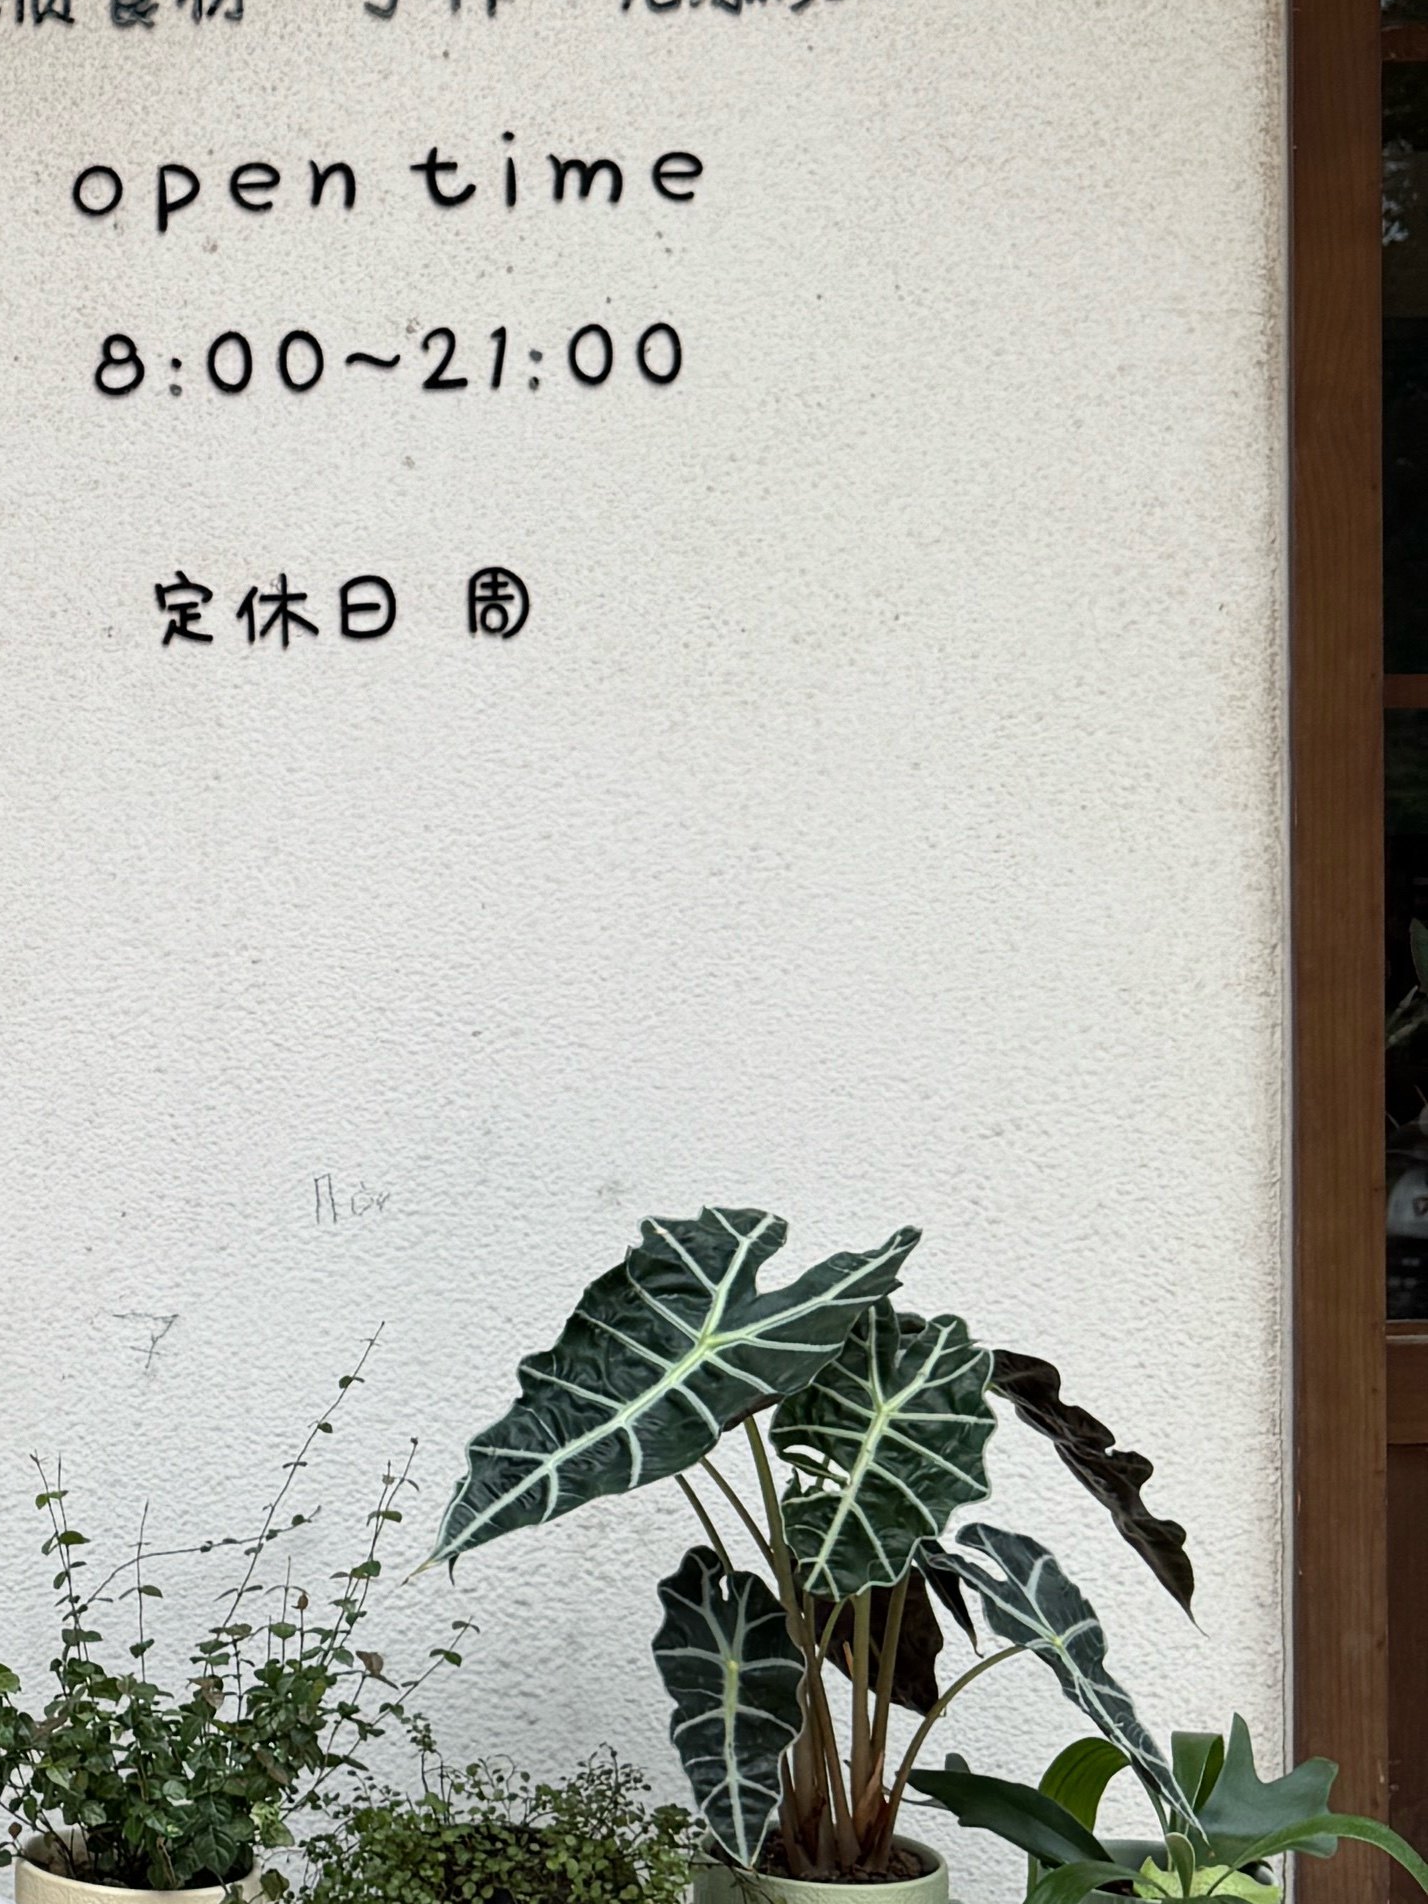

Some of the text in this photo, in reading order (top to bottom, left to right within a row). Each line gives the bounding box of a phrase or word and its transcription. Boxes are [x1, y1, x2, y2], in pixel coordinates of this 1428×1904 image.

[70, 130, 705, 235] open time
[93, 321, 684, 399] 8:00~21:00
[153, 565, 532, 650] 定休日 周
